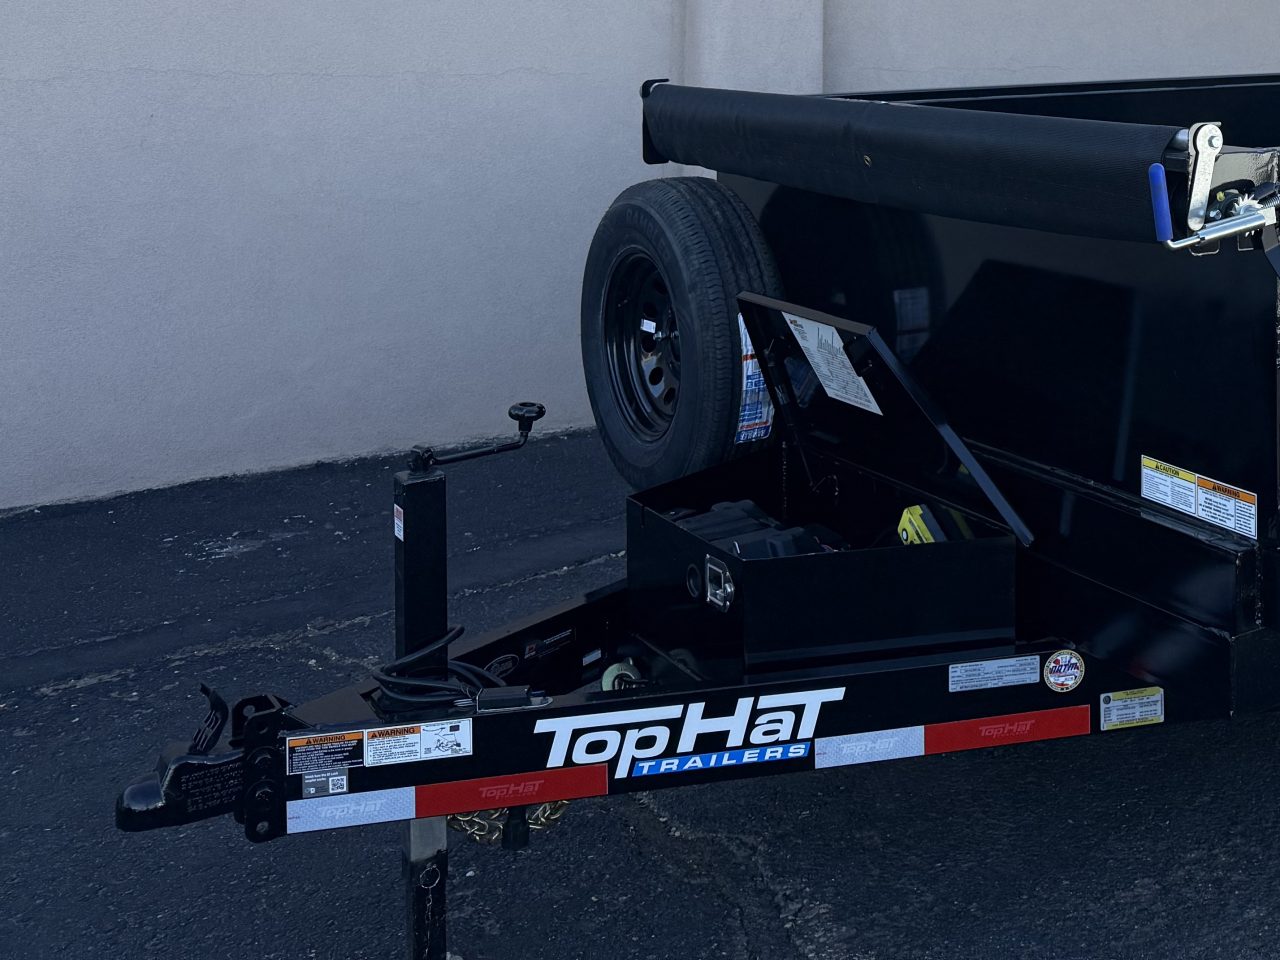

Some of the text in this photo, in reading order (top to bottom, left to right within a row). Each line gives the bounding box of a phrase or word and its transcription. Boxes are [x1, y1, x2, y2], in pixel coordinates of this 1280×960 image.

[1159, 464, 1180, 477] CAUTION
[376, 726, 416, 738] WARNING
[311, 734, 346, 744] WARNING
[638, 743, 807, 775] TRAILERS
